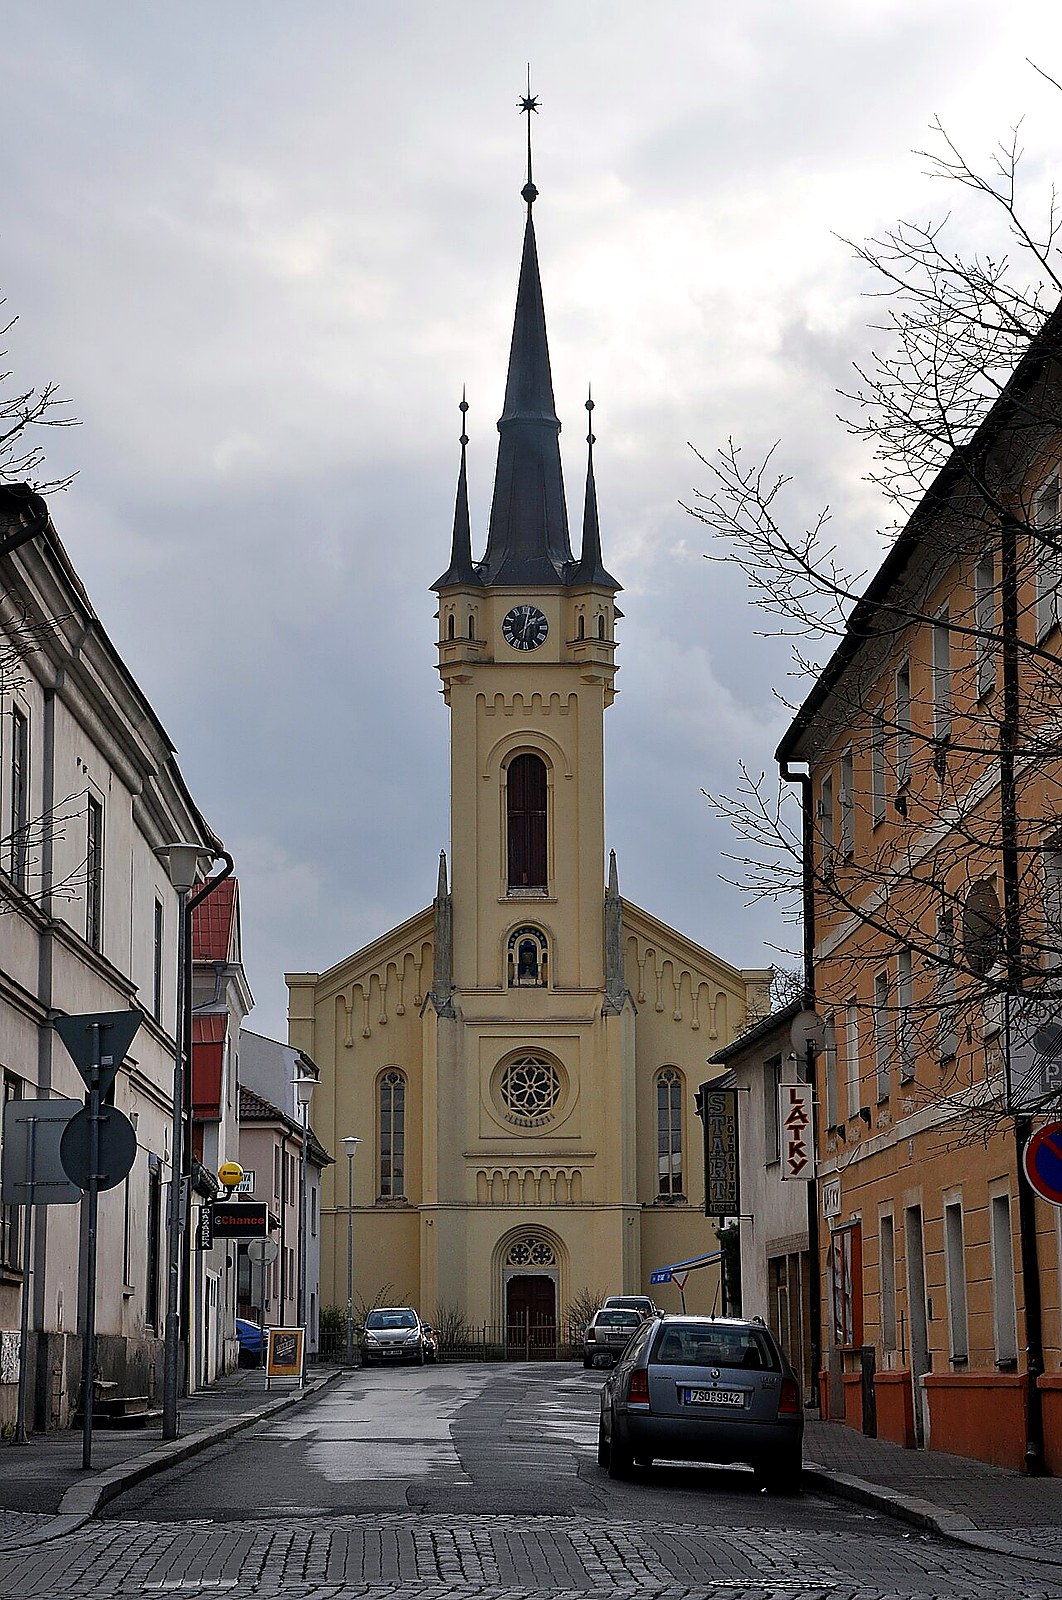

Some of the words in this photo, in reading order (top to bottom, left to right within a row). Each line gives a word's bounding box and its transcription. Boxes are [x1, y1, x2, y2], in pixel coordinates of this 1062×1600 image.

[708, 1093, 727, 1200] START
[726, 1115, 736, 1200] POTRAVINY
[784, 1088, 809, 1176] LÁTKY
[201, 1208, 210, 1247] BAZAREK
[221, 1215, 265, 1225] Chance
